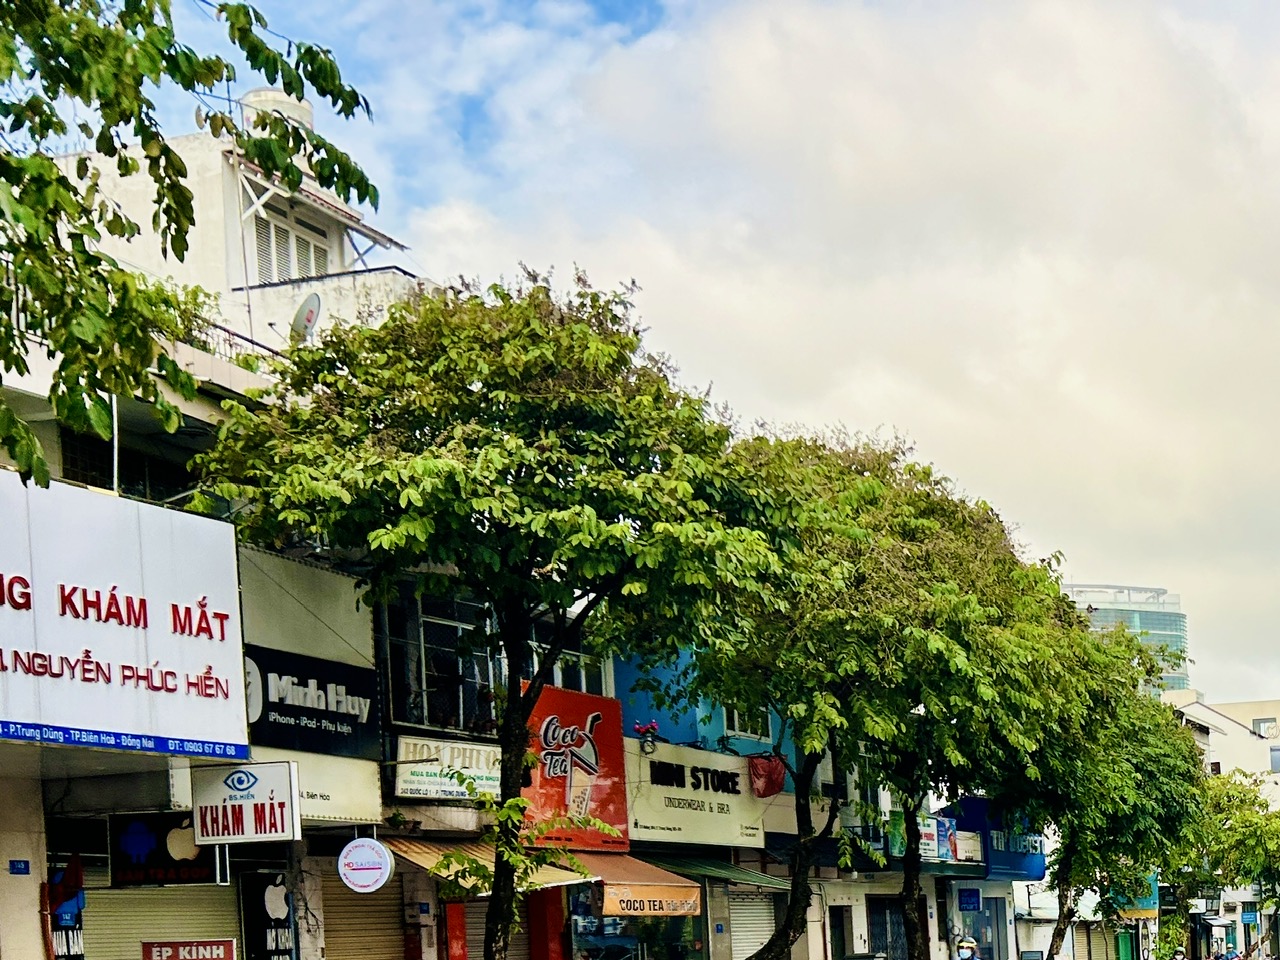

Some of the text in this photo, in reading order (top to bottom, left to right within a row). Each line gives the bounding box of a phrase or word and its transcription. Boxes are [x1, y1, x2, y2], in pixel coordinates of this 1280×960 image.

[0, 573, 230, 641] G KHÁM MẮT
[12, 649, 111, 684] NGUYỄN
[119, 661, 177, 692] PHÚC
[267, 673, 371, 723] Minh Huy
[268, 712, 295, 724] iPhone
[300, 717, 317, 728] iPad
[541, 715, 580, 749] Coco
[542, 749, 569, 778] Tea
[690, 766, 741, 795] STORE
[200, 789, 286, 838] KHÁM MẮT
[664, 797, 706, 812] UNDERWEAR
[619, 899, 645, 911] COCO
[647, 899, 664, 911] TEA
[152, 943, 225, 960] ÉP KÍNH
